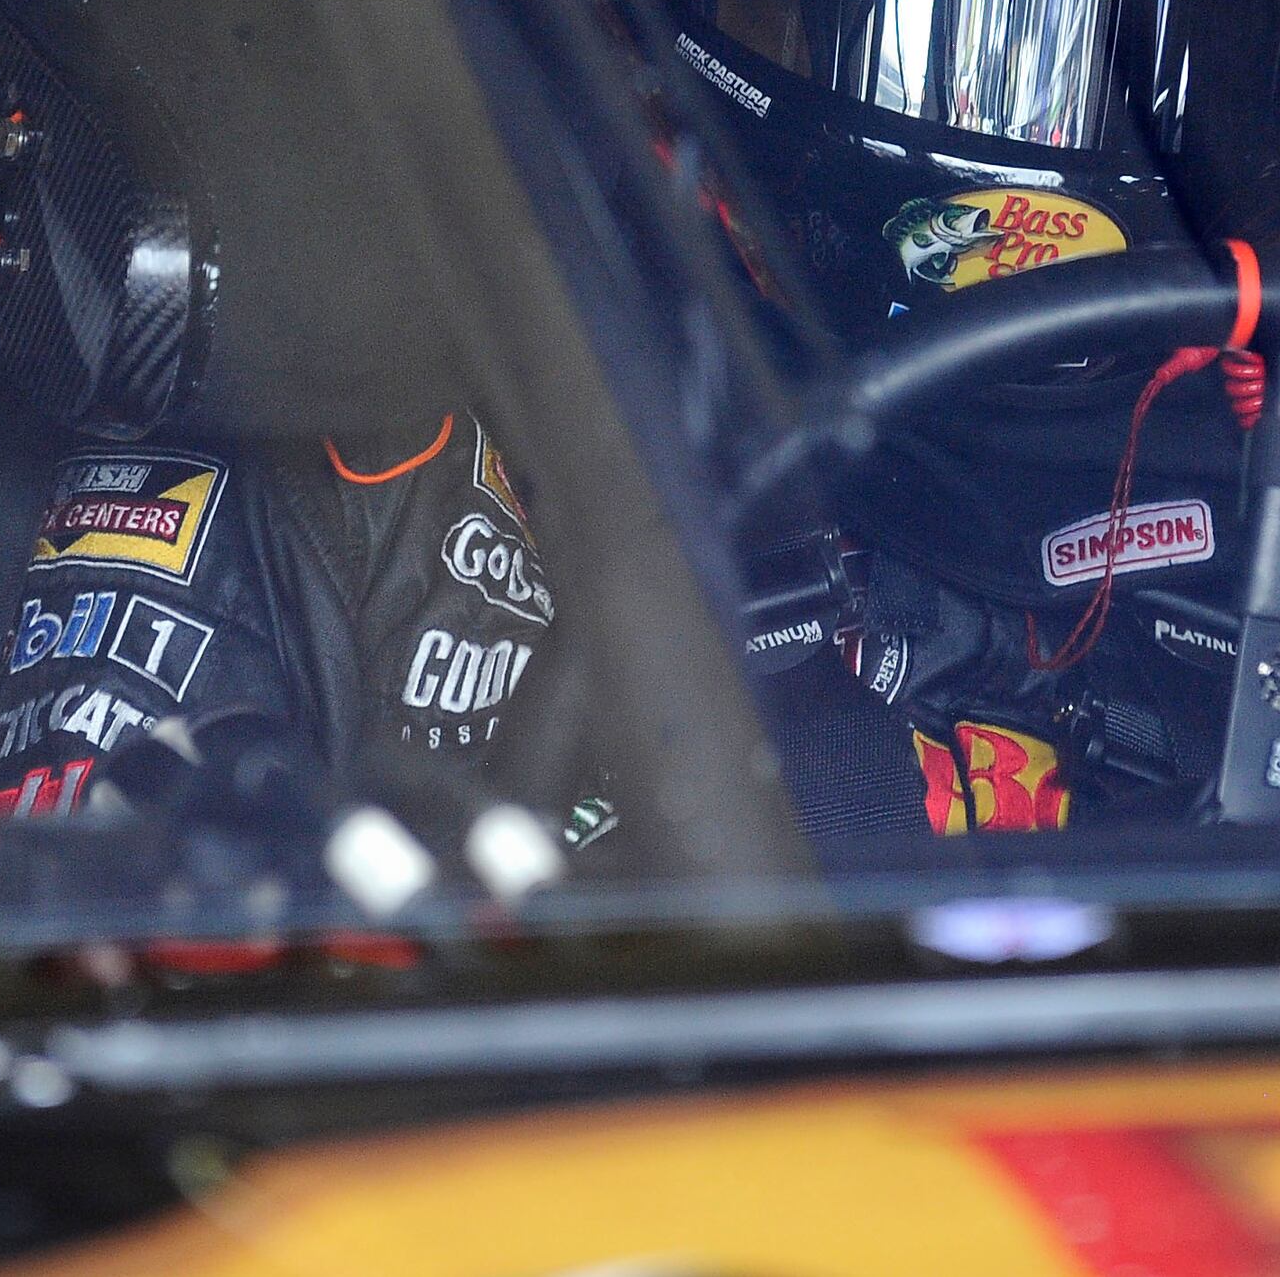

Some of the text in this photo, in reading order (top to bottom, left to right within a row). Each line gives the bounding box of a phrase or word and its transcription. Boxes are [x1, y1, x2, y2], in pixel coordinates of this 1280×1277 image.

[677, 32, 772, 111] NICK PASTURA
[989, 193, 1089, 240] Bass
[64, 502, 180, 540] CENTERS
